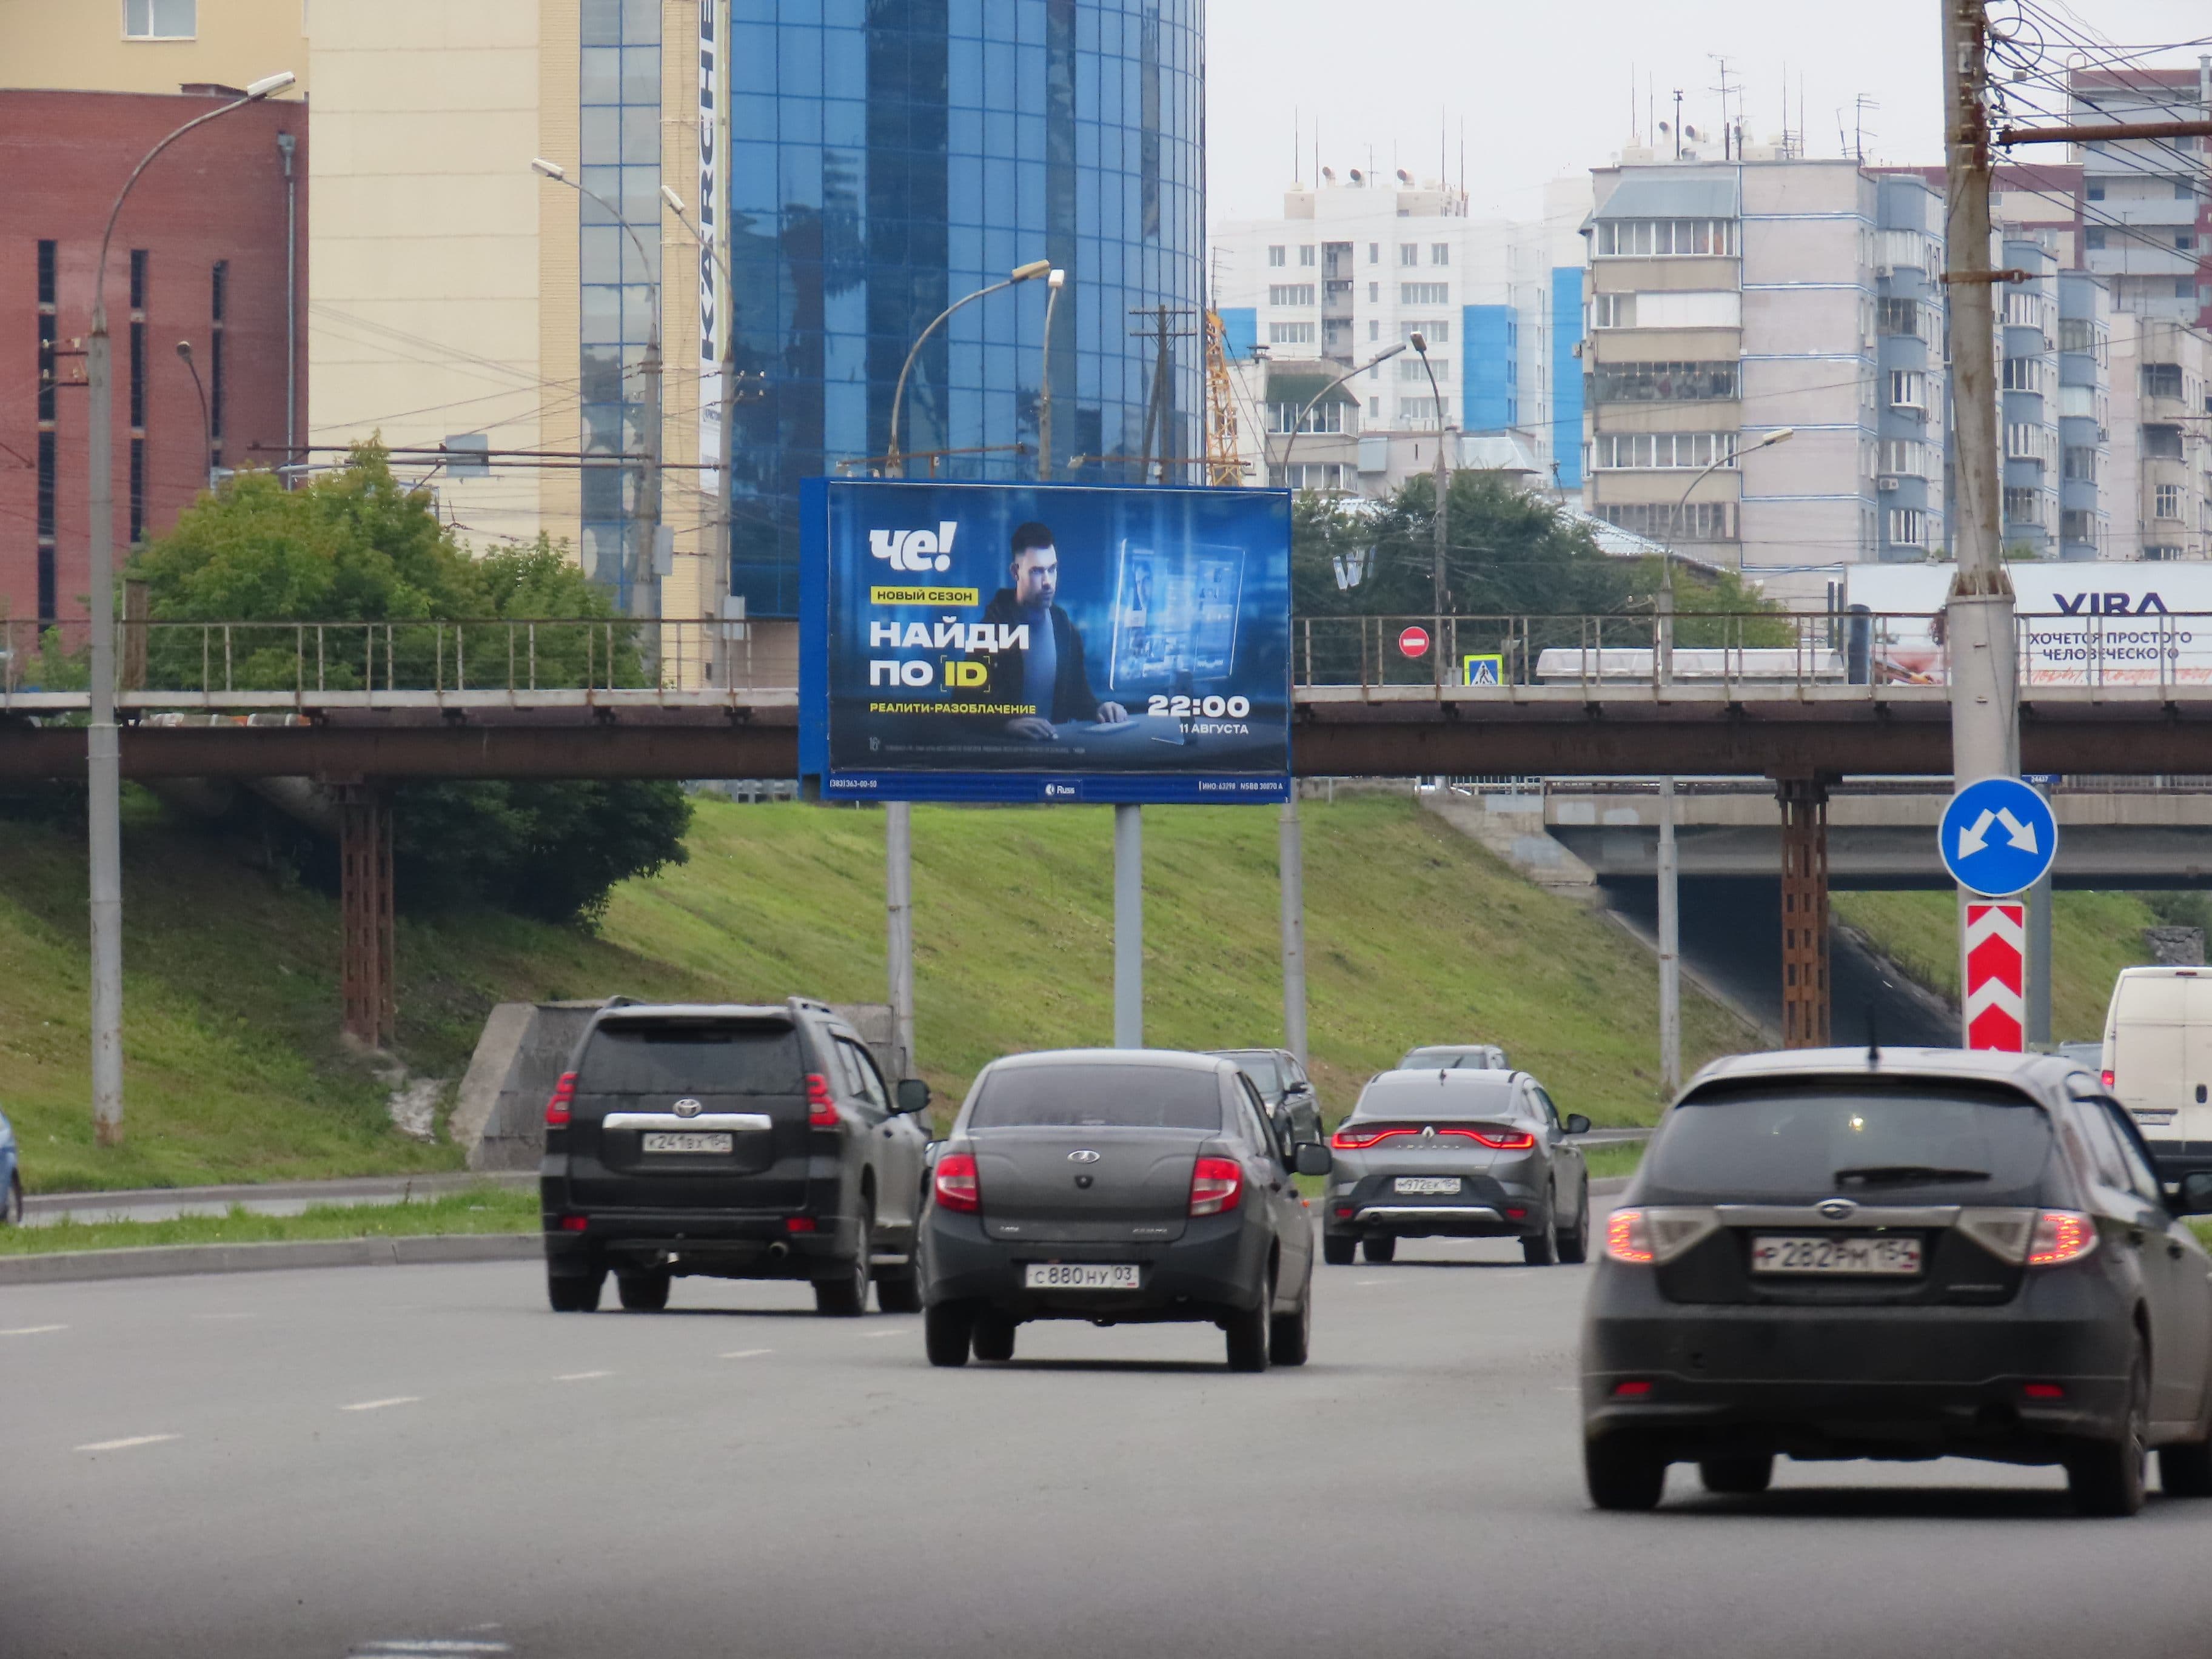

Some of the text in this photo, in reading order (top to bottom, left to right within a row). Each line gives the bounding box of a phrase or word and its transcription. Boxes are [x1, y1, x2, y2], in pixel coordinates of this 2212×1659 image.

[877, 589, 972, 601] НОВЫЙ СЕЗОН
[2053, 592, 2169, 617] VIRA
[870, 615, 1029, 653] НАЙДИ
[870, 660, 987, 686] ПО ID
[870, 703, 1036, 714] РЕАЛИТИ-РАЗОБЛАЧЕНИЕ
[1148, 694, 1250, 717] 22:00
[1179, 723, 1248, 734] 11 АВГУСТА
[1115, 1266, 1133, 1281] 03
